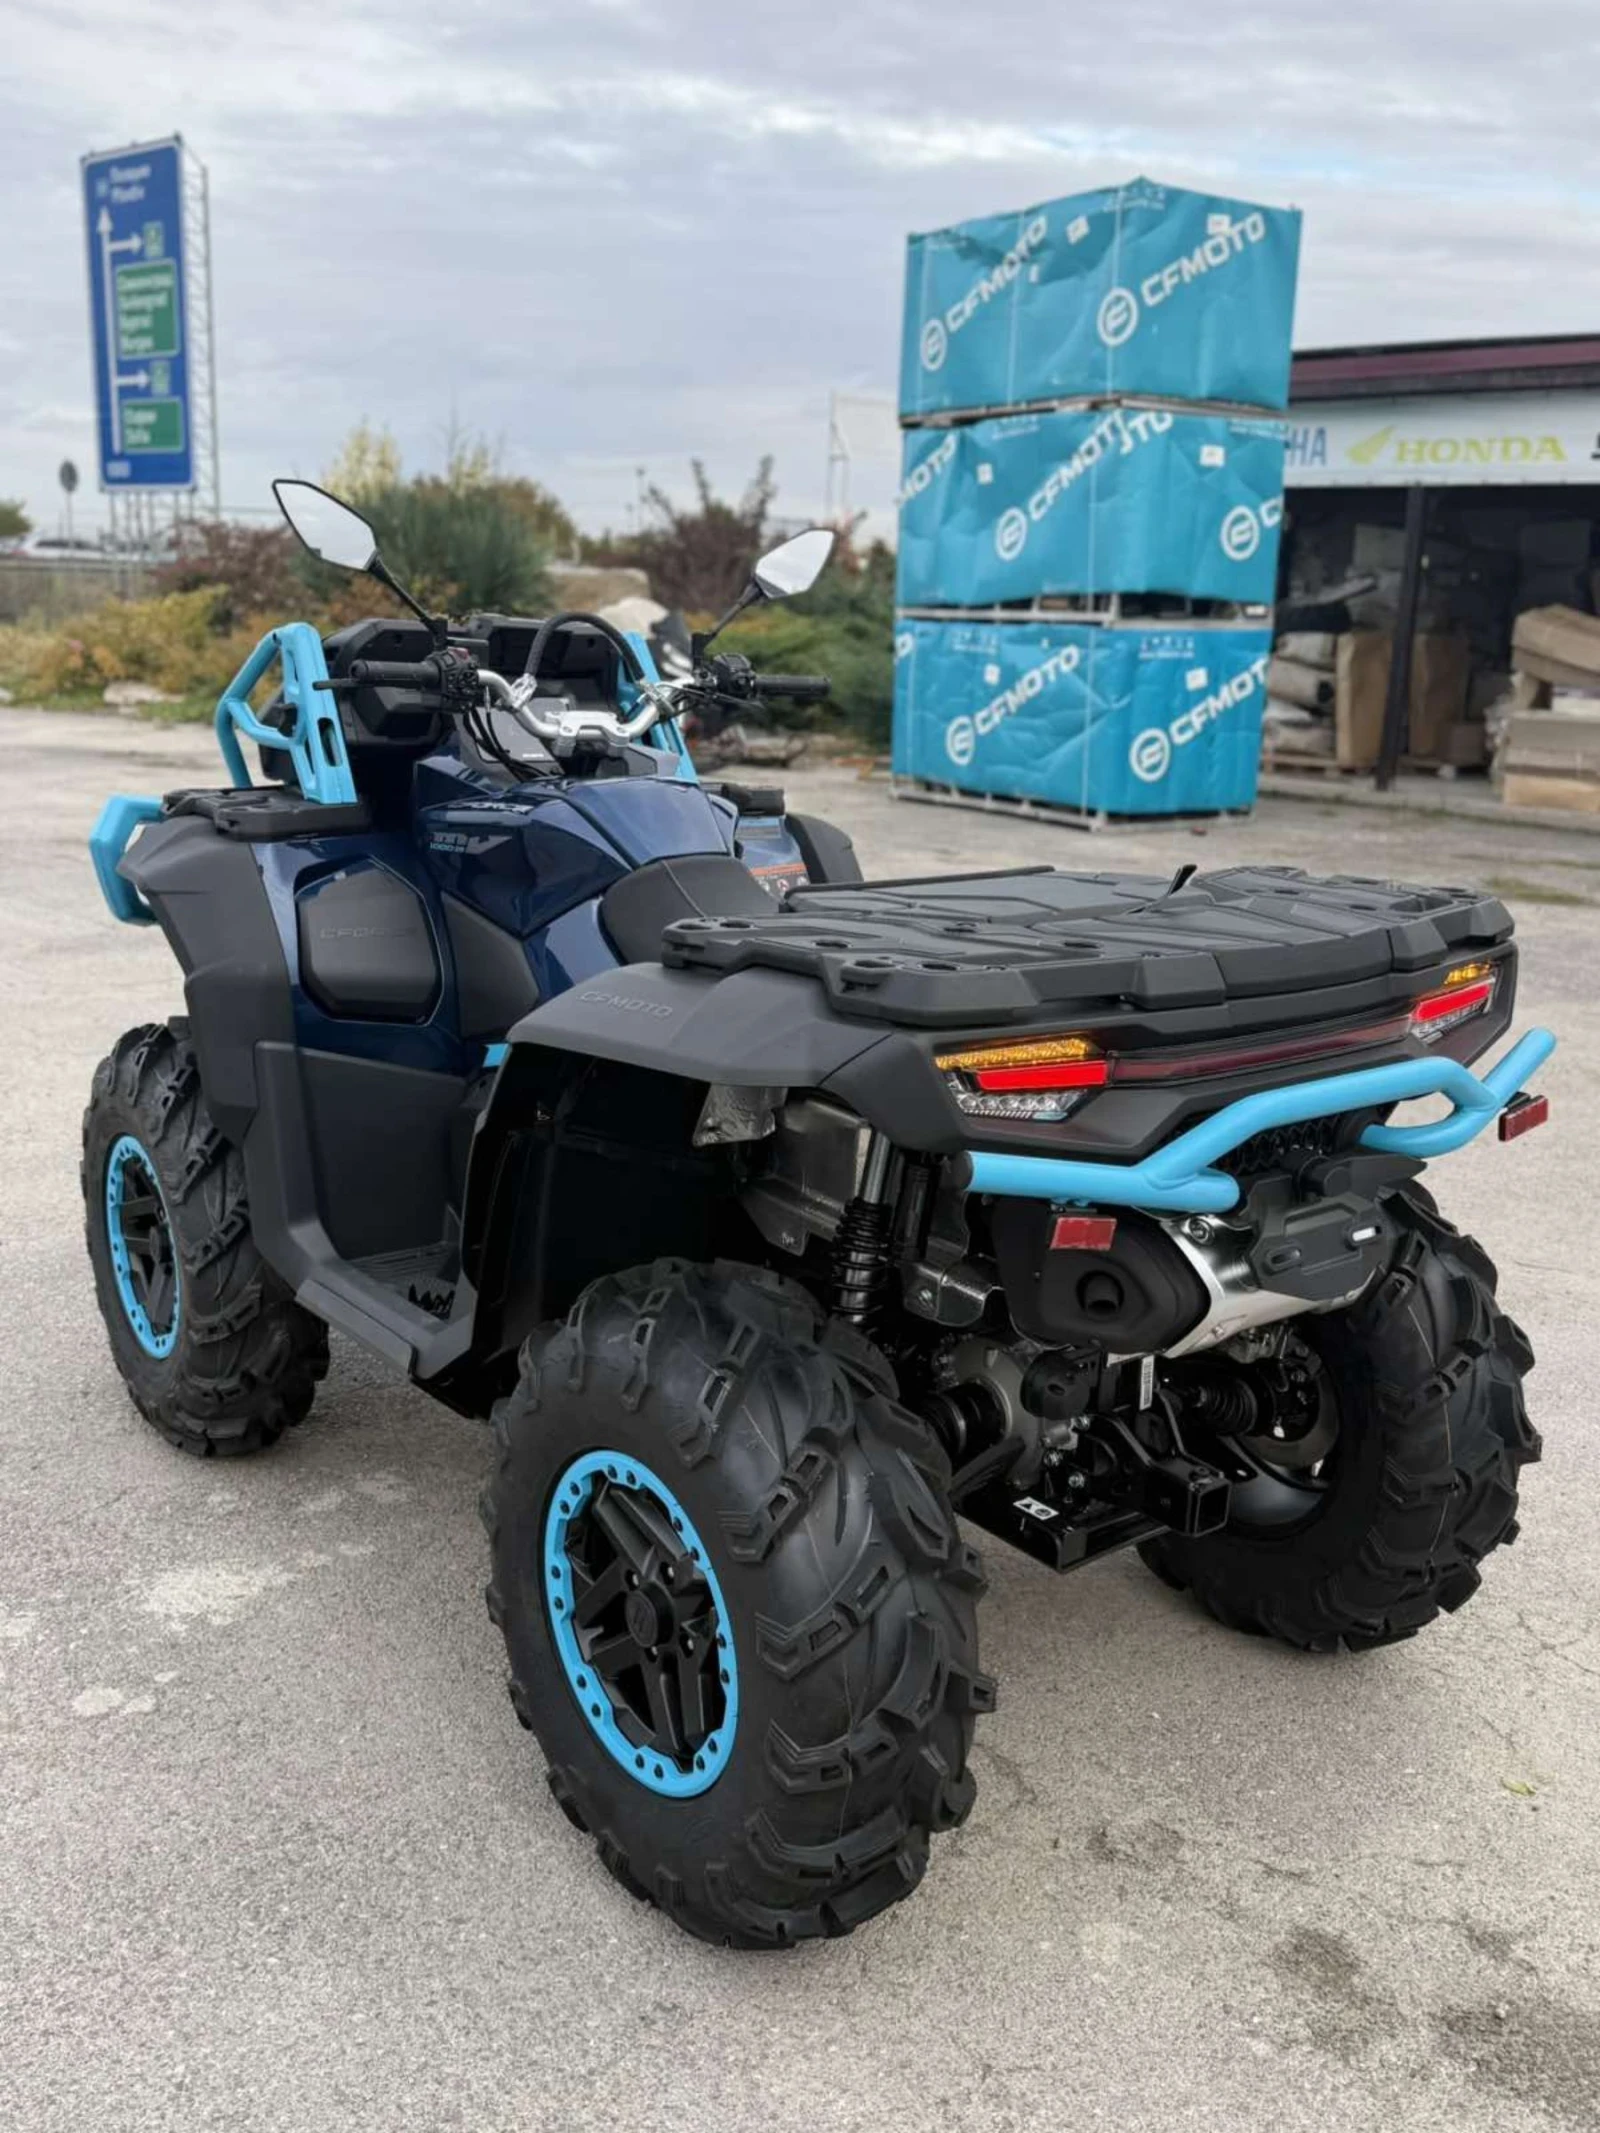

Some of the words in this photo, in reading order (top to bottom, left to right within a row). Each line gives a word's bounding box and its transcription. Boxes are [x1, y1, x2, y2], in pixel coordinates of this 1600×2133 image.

[944, 217, 1048, 332] CFMOTO
[1140, 212, 1265, 306] CFMOTO
[1396, 434, 1568, 464] HONDA
[973, 644, 1081, 736] CFMOTO
